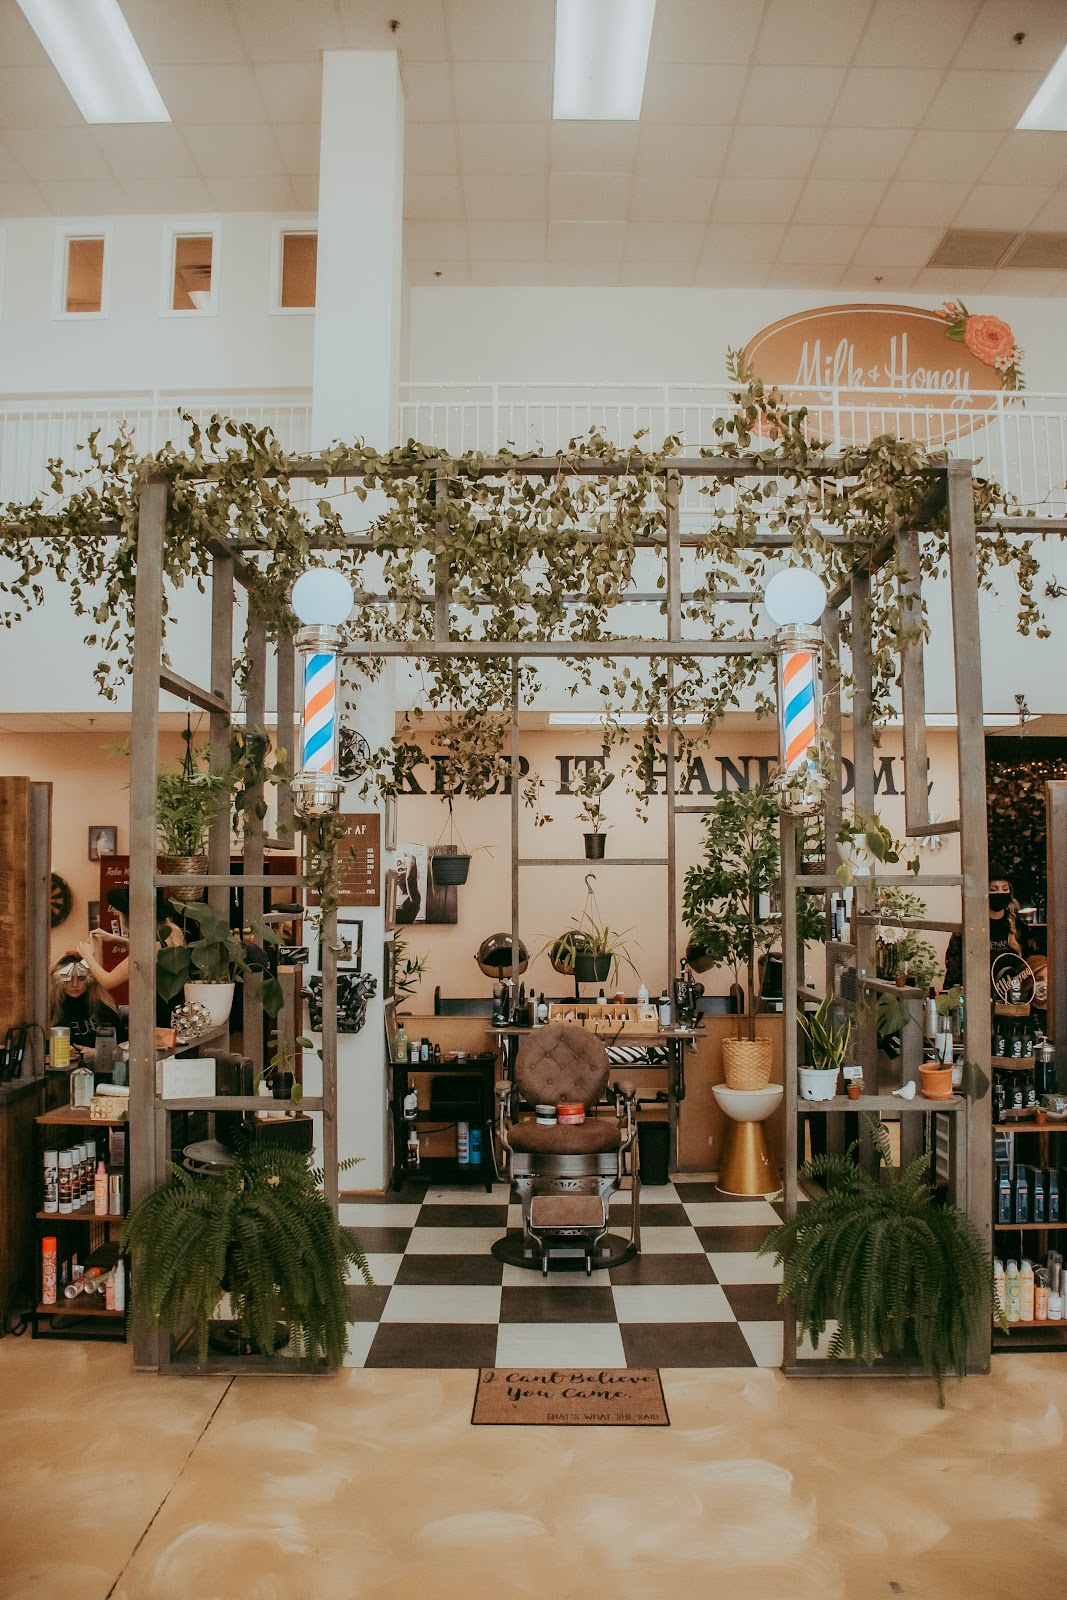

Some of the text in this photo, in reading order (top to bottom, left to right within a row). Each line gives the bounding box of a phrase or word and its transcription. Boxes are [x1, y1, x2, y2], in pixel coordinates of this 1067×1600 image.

[789, 338, 866, 402] Milk
[884, 332, 973, 410] Honey
[569, 1371, 655, 1384] Believe
[506, 1386, 555, 1402] You
[584, 1413, 611, 1421] WHAT
[616, 1413, 634, 1421] SHE
[637, 1413, 660, 1421] SAID
